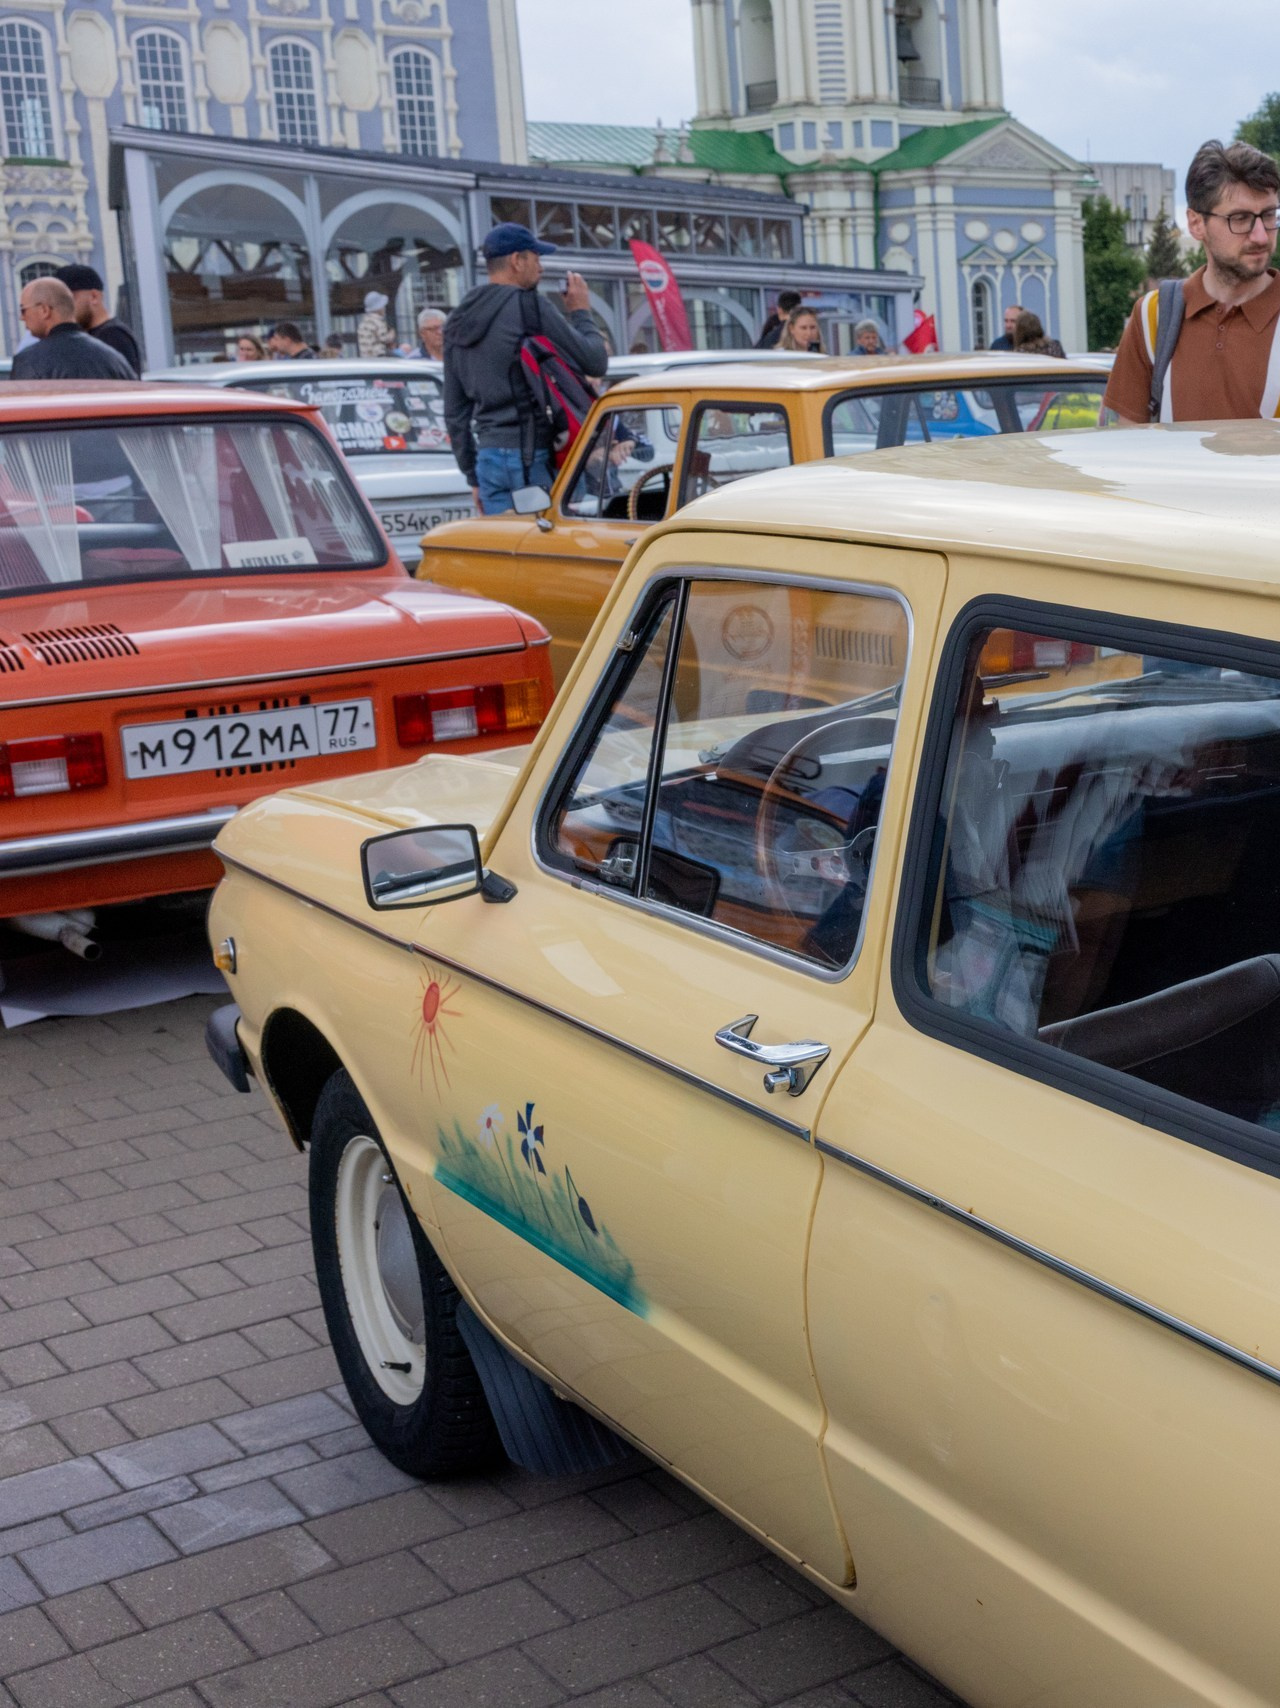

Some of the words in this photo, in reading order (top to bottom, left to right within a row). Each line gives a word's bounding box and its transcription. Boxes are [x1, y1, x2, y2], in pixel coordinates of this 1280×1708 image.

[330, 421, 388, 440] IGMAN
[138, 722, 309, 770] М912МА
[323, 706, 359, 736] 77
[328, 735, 357, 749] RUS
